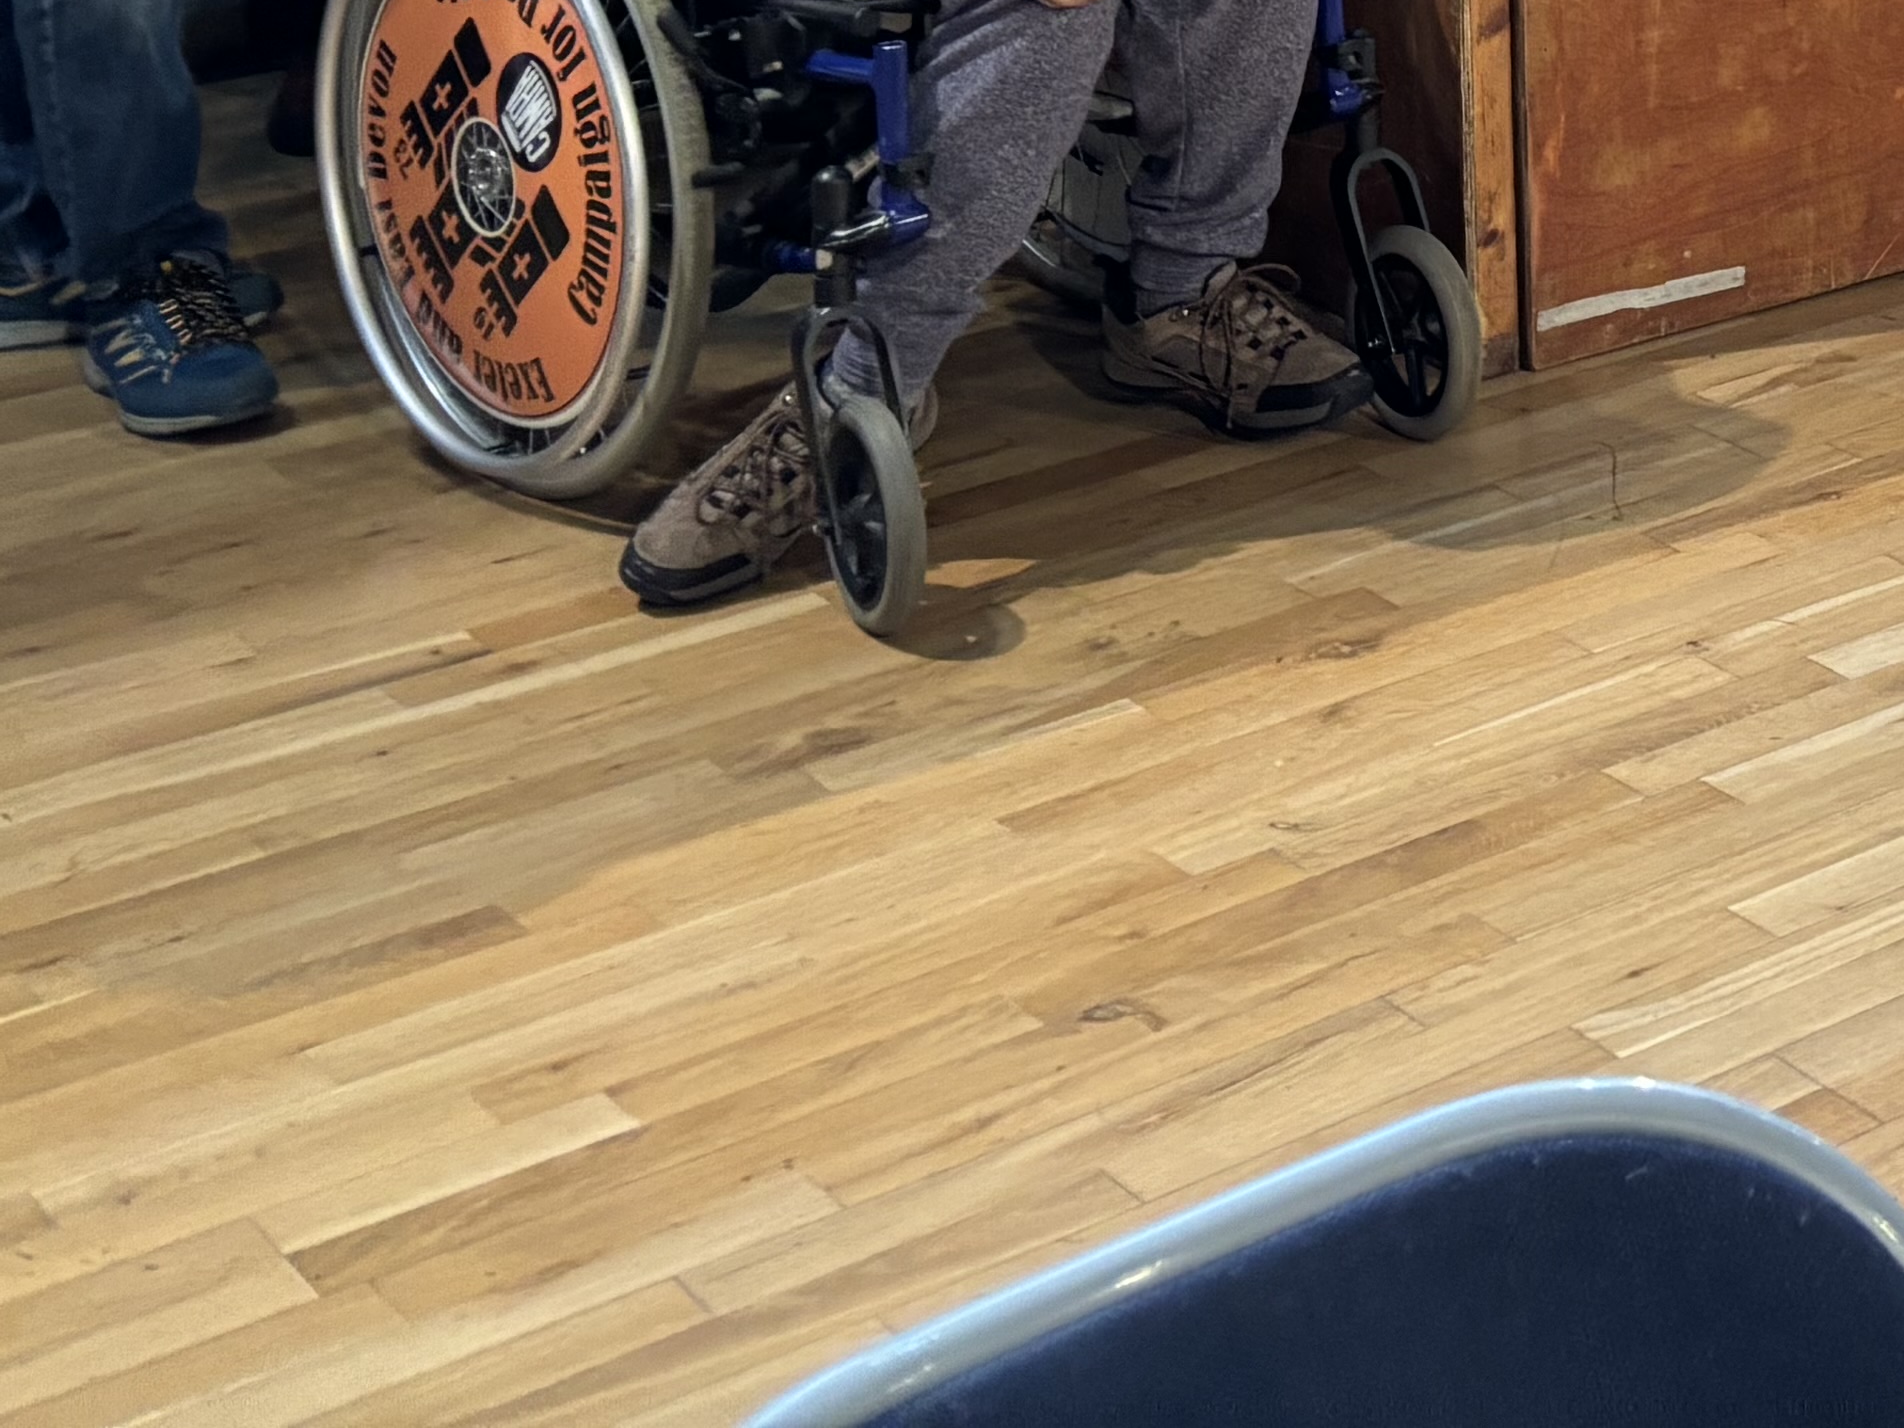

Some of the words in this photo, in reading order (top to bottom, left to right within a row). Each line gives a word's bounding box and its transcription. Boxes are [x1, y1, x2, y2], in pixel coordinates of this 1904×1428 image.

[540, 4, 586, 82] for
[366, 38, 399, 181] Devon
[505, 61, 558, 164] CAMRA
[567, 80, 612, 326] Campaign
[472, 346, 556, 404] Exeter
